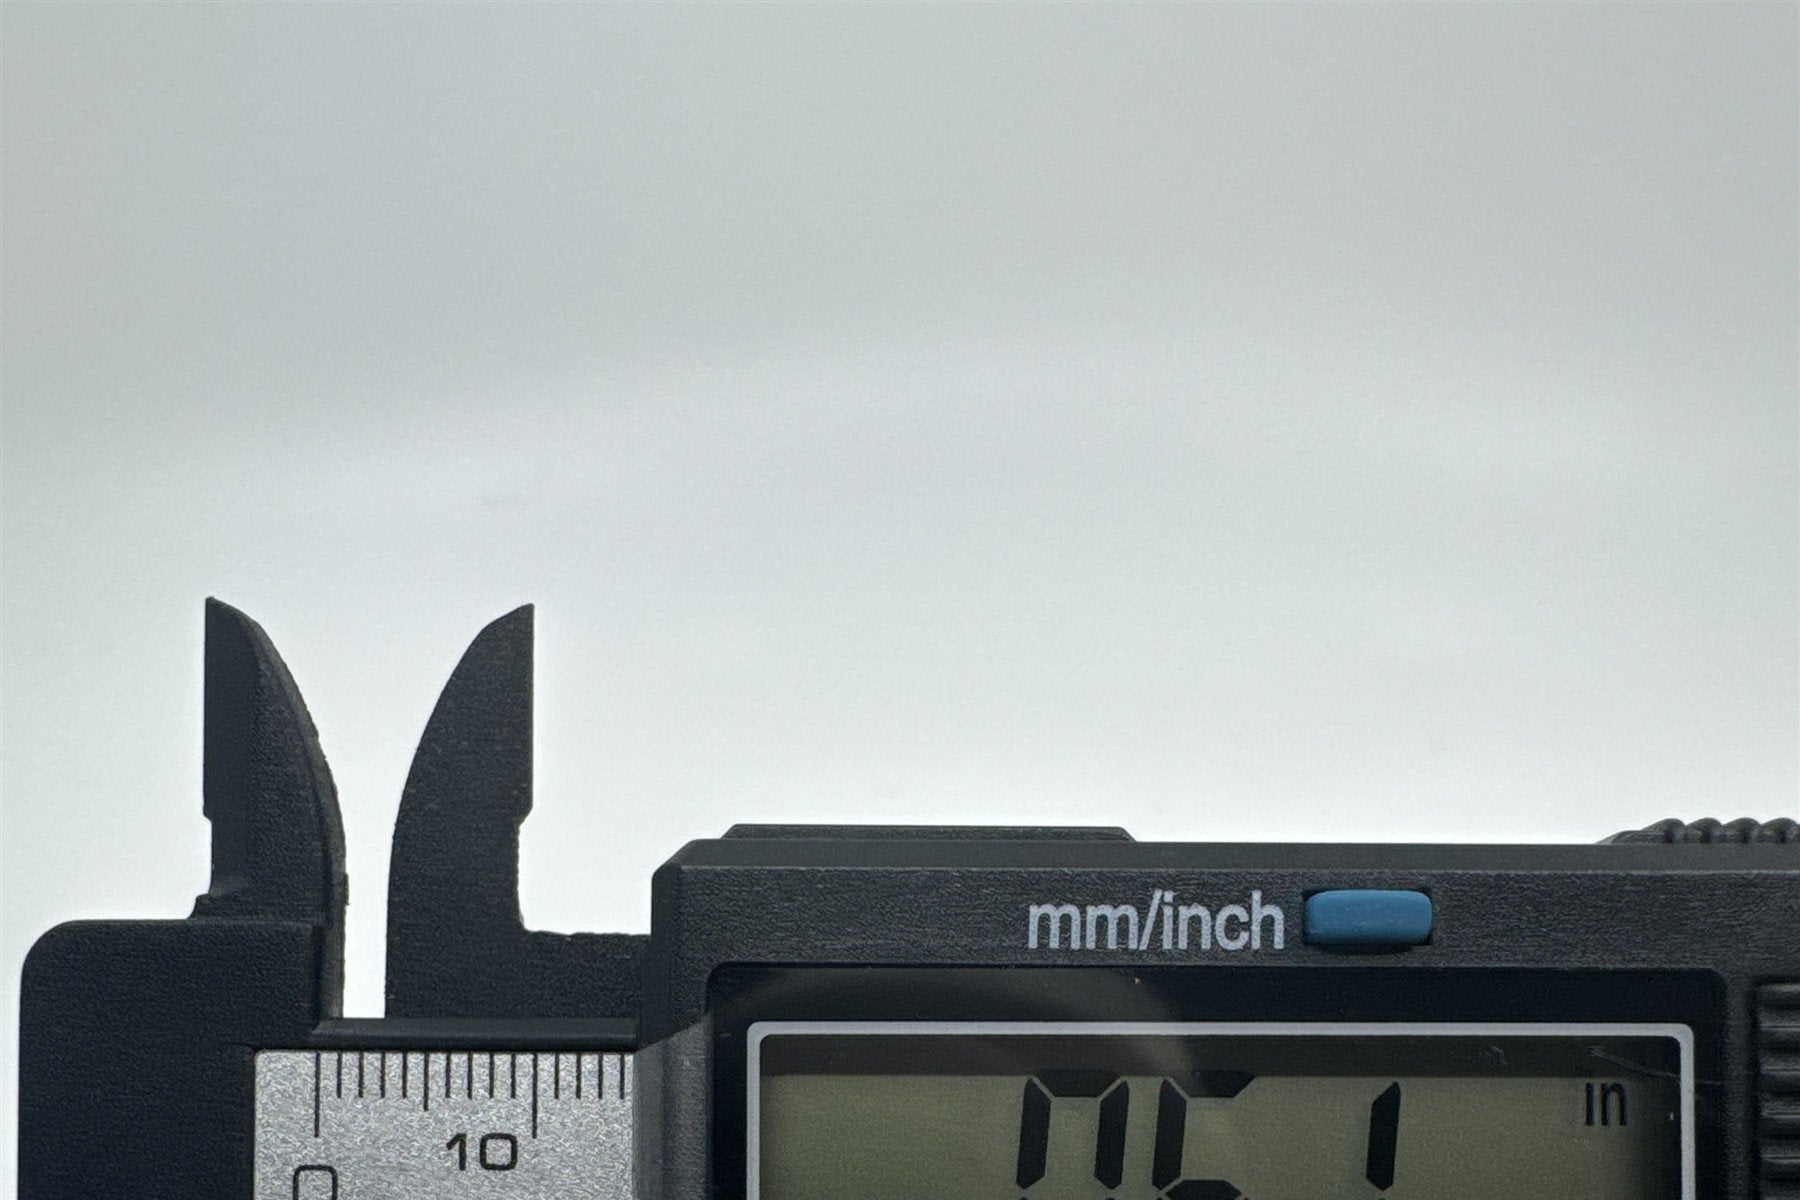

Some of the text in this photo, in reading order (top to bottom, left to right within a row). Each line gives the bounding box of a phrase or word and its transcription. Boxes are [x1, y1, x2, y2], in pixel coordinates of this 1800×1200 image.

[1027, 889, 1285, 951] mm/inch
[1584, 1081, 1629, 1127] in
[446, 1132, 519, 1172] 10
